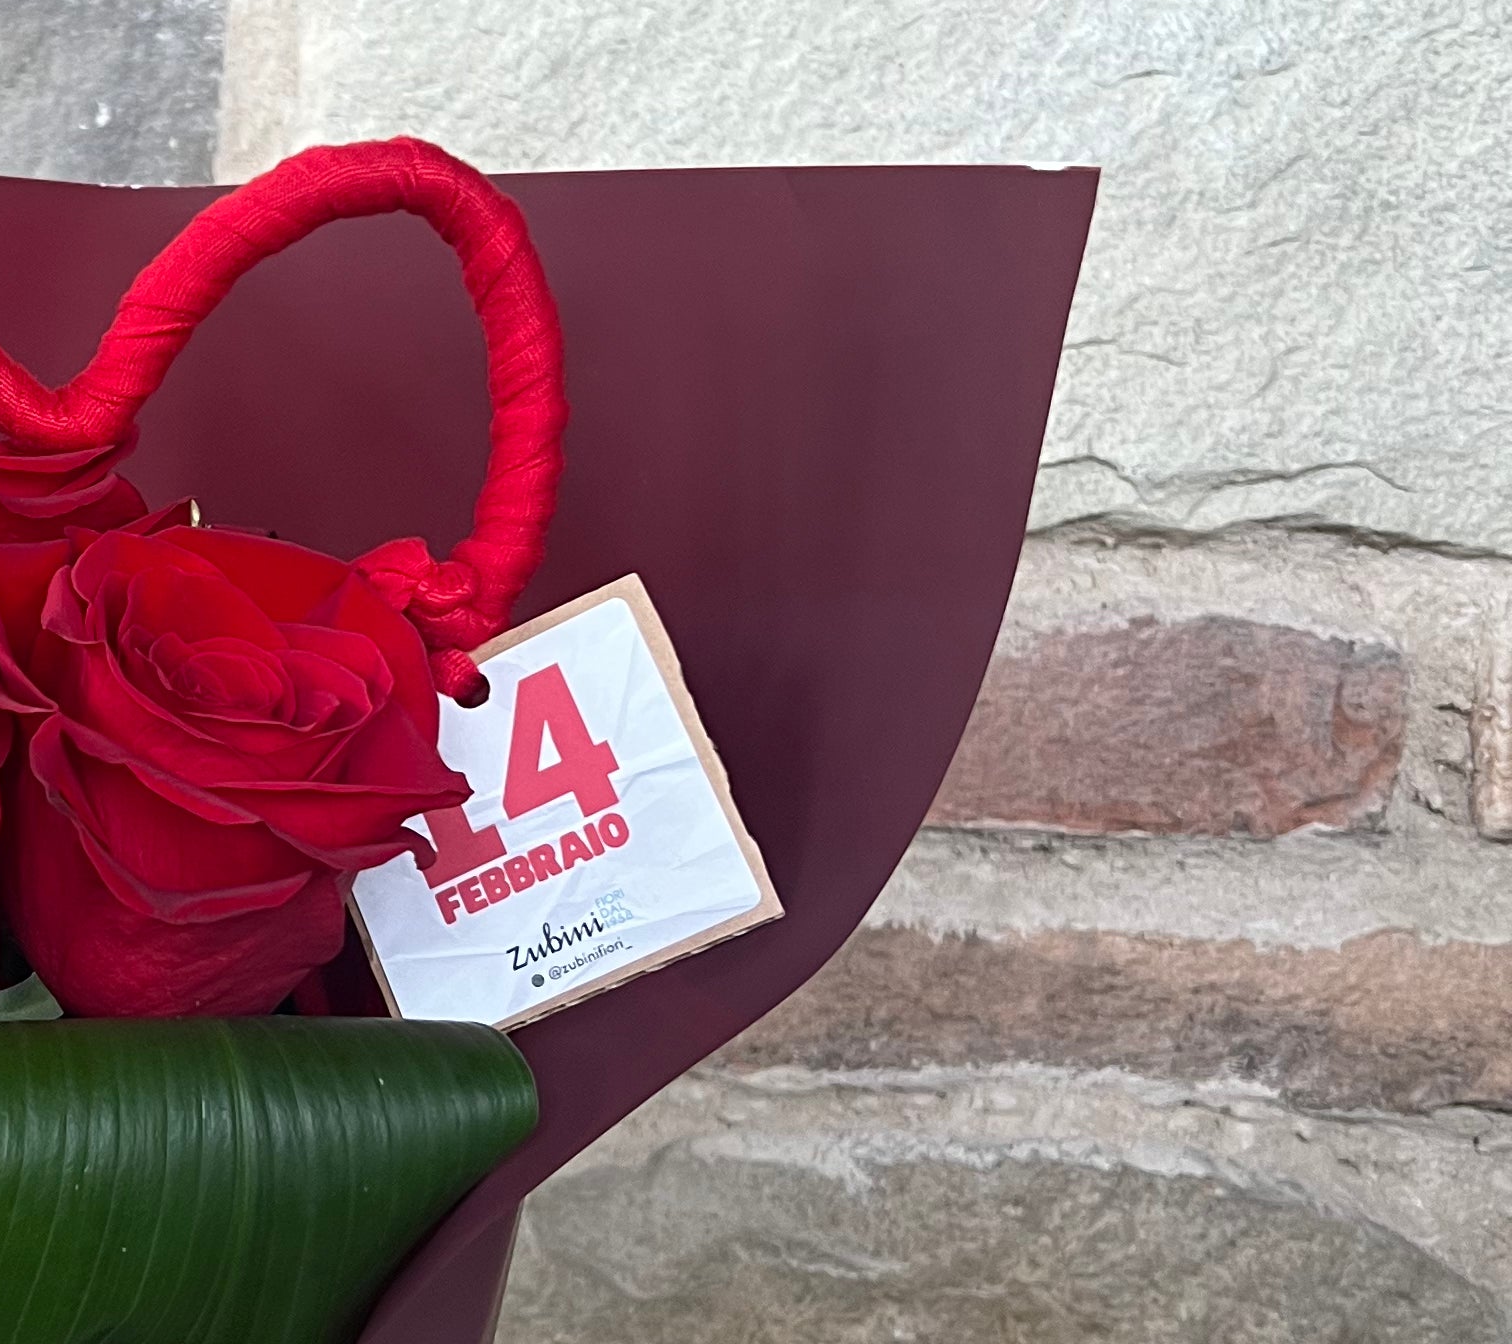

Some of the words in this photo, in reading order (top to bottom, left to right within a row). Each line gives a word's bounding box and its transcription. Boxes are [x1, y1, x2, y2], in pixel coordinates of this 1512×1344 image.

[434, 813, 630, 925] FEBBRAIO
[595, 887, 625, 908] FIORI
[599, 902, 625, 918] DAL
